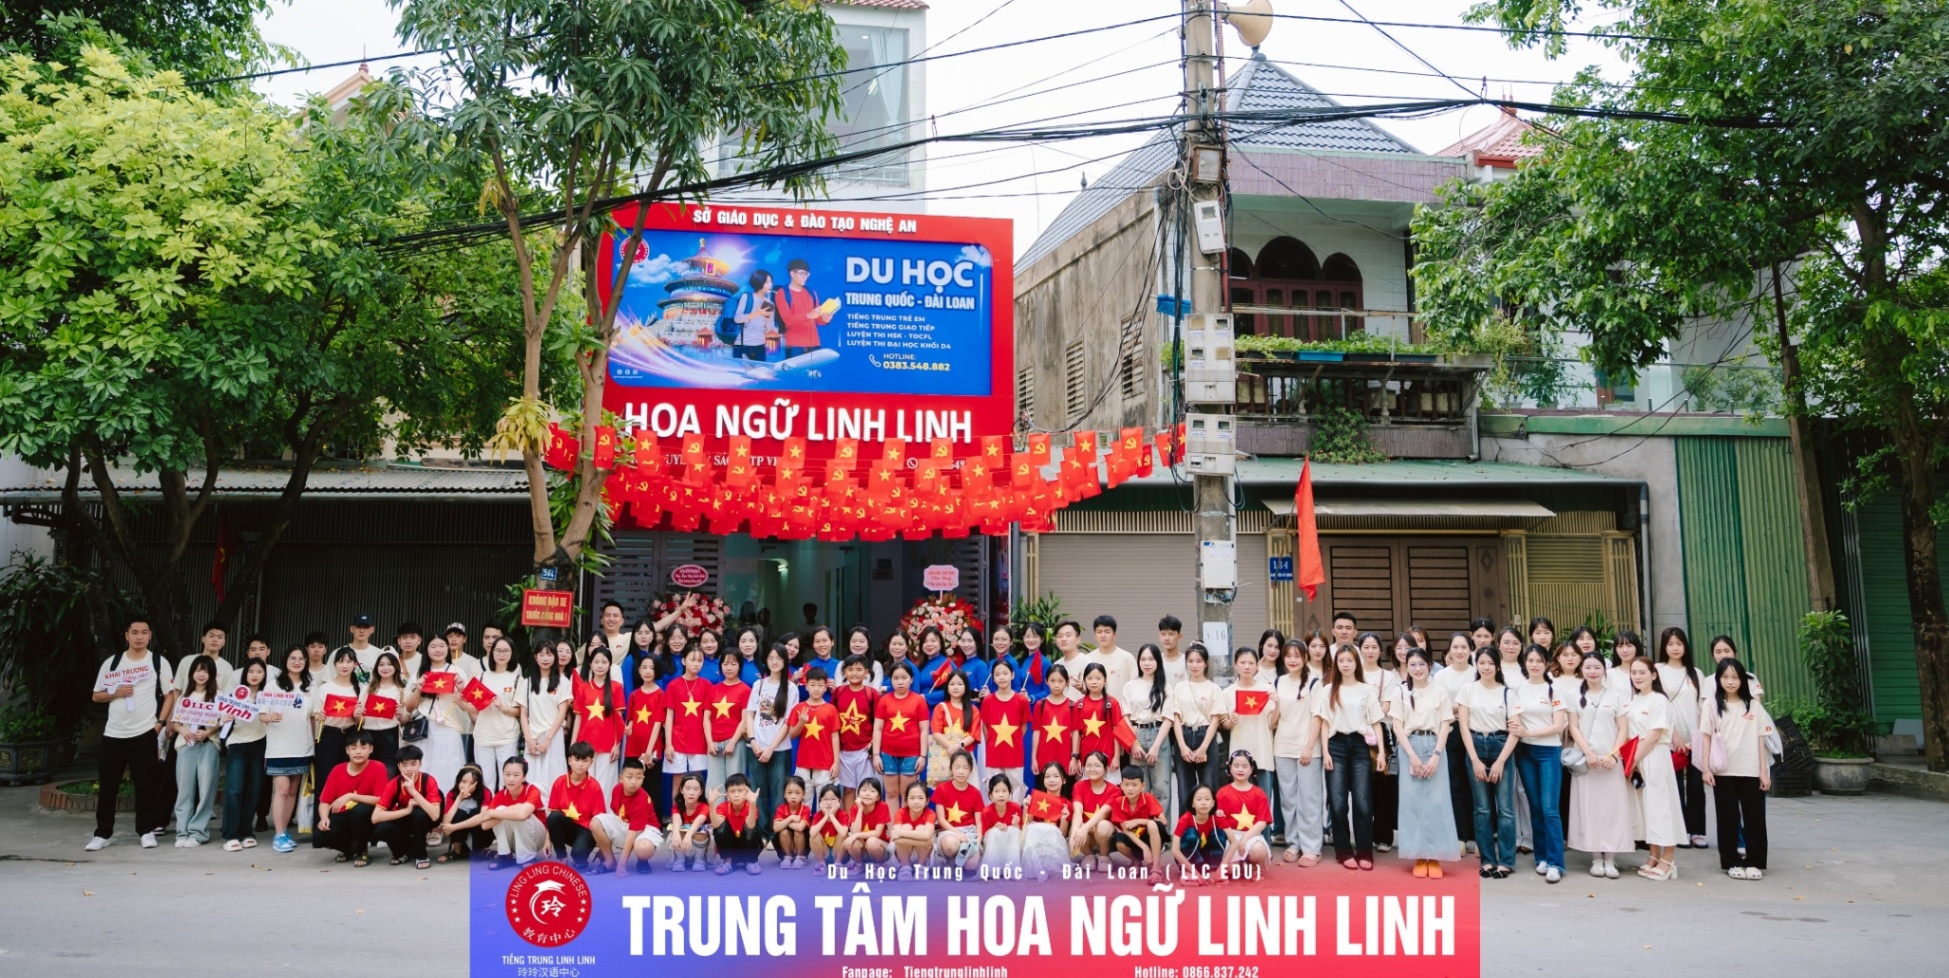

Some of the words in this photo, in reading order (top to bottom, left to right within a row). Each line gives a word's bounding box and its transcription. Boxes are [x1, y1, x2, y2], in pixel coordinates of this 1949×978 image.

[693, 209, 711, 224] SỞ
[717, 211, 747, 225] GIÁO
[753, 213, 779, 229] DỤC
[784, 215, 794, 227] &
[800, 213, 826, 229] ĐÀO
[831, 216, 855, 232] TẠO
[860, 216, 894, 234] NGHỆ
[898, 219, 917, 233] AN
[846, 256, 894, 285] DU
[902, 259, 974, 294] HỌC
[845, 292, 882, 306] TRUNG
[885, 290, 914, 307] QUỐC
[924, 294, 943, 308] ĐÀI
[946, 296, 975, 310] LOAN
[847, 312, 869, 320] TIẾNG
[898, 314, 913, 322] TRẺ
[847, 321, 869, 329] TIẾNG
[919, 323, 935, 331] TIẾP
[847, 330, 871, 339] LUYỆN
[847, 339, 871, 347] LUYỆN
[887, 341, 901, 349] ĐẠI
[920, 340, 939, 349] KHỐI
[883, 361, 950, 372] 0383.548.882
[625, 402, 701, 438] HOA
[715, 397, 799, 440] NGỮ
[808, 408, 885, 442] LINH
[897, 409, 972, 443] LINH
[191, 702, 214, 711] LLC
[218, 701, 252, 720] Vinh
